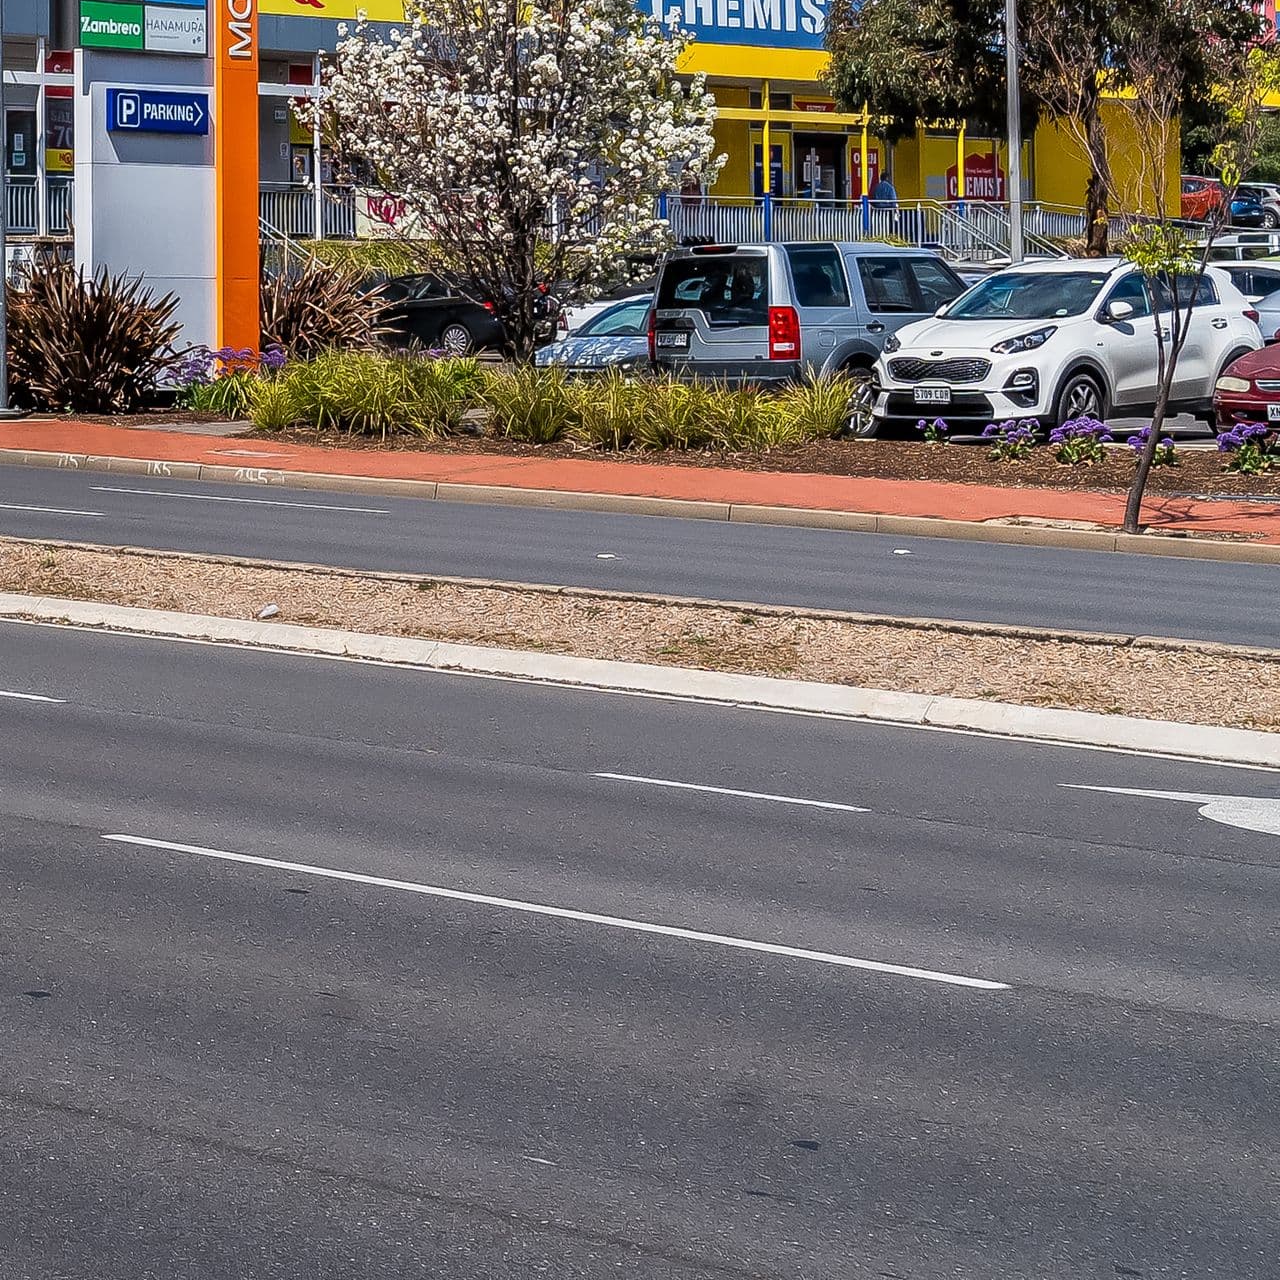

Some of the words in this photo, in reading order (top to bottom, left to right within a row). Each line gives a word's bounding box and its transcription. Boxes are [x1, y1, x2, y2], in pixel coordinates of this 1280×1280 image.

[80, 16, 141, 36] Zambrero
[146, 19, 205, 34] HANAMURA
[122, 98, 135, 123] P
[143, 103, 194, 121] PARKING
[853, 152, 877, 164] OEN
[950, 176, 1002, 198] CEMIST
